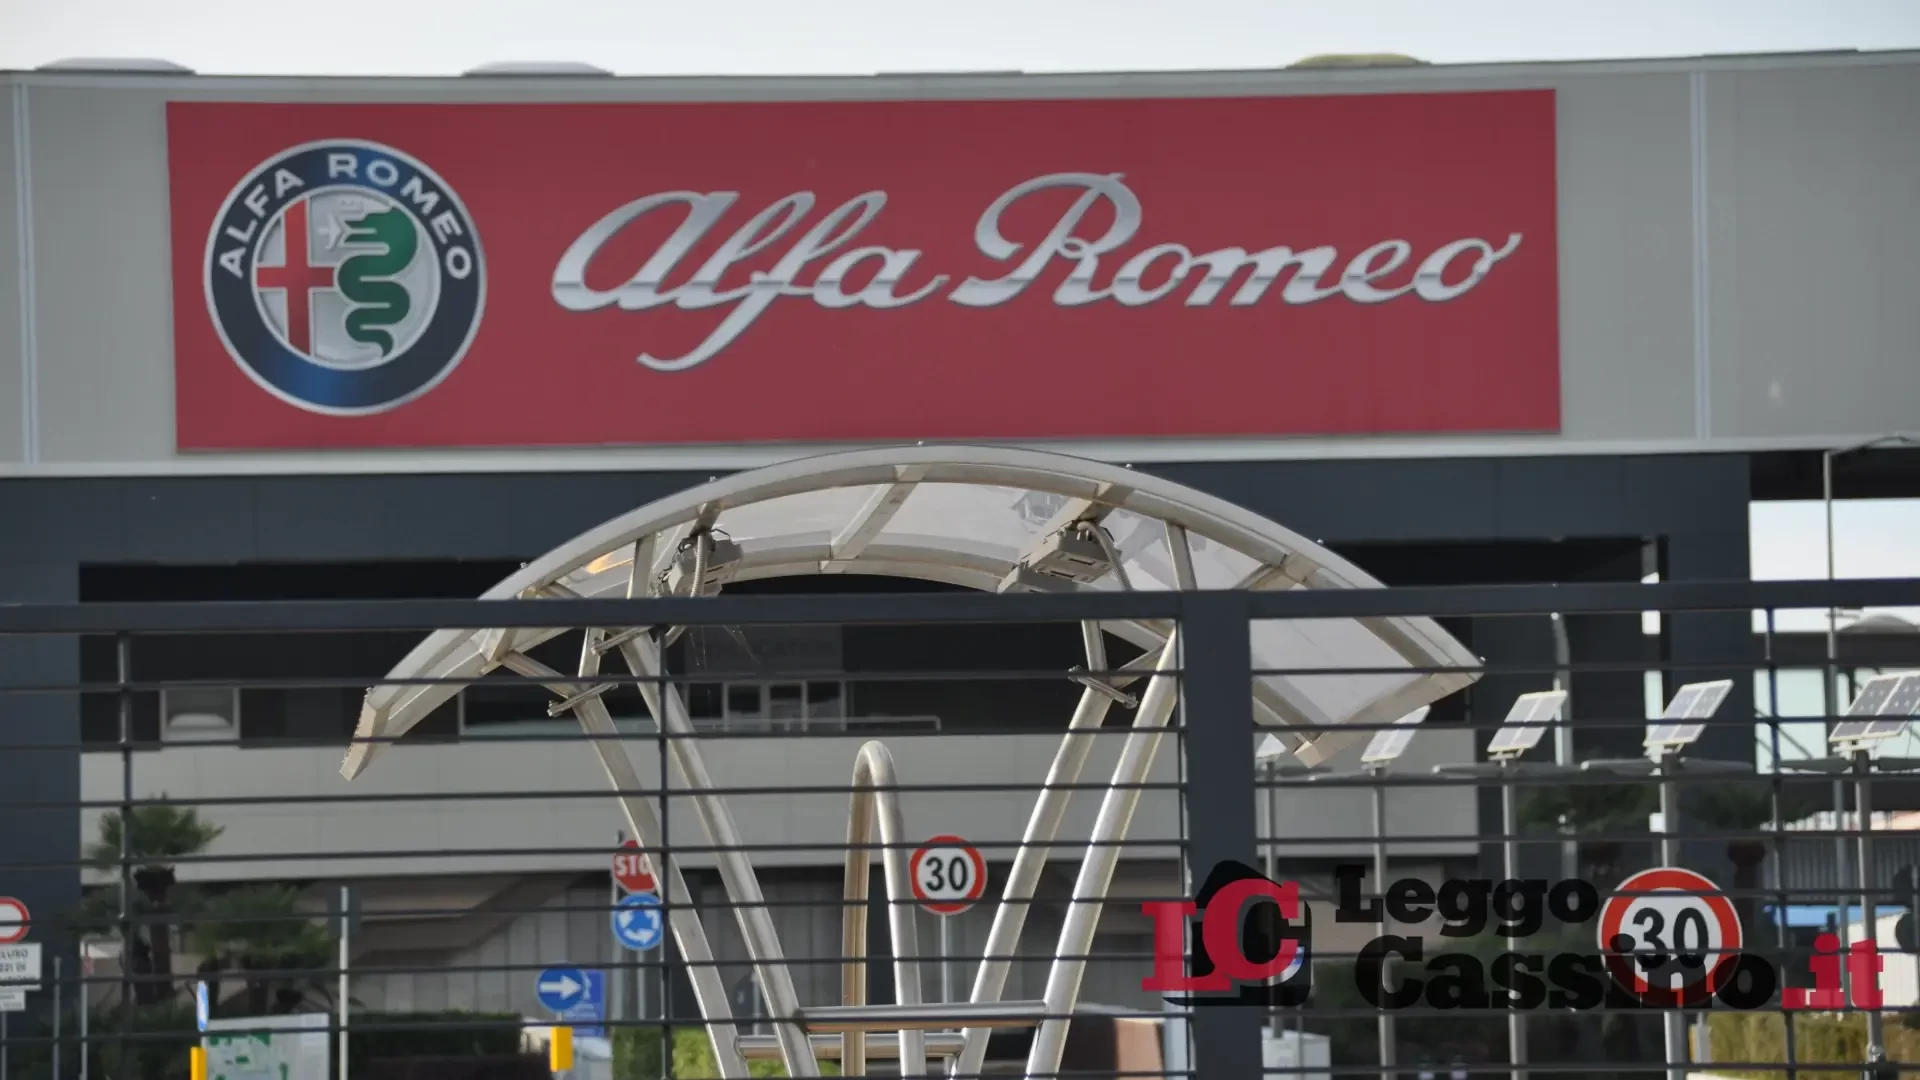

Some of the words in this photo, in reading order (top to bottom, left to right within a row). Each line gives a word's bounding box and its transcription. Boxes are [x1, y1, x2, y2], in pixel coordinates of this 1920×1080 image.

[219, 168, 305, 279] ALFA
[328, 153, 472, 280] ROMEO
[551, 190, 949, 371] Alfa
[949, 172, 1521, 306] Romeo
[616, 855, 652, 877] STO
[925, 855, 968, 892] 30
[1632, 907, 1709, 969] 30
